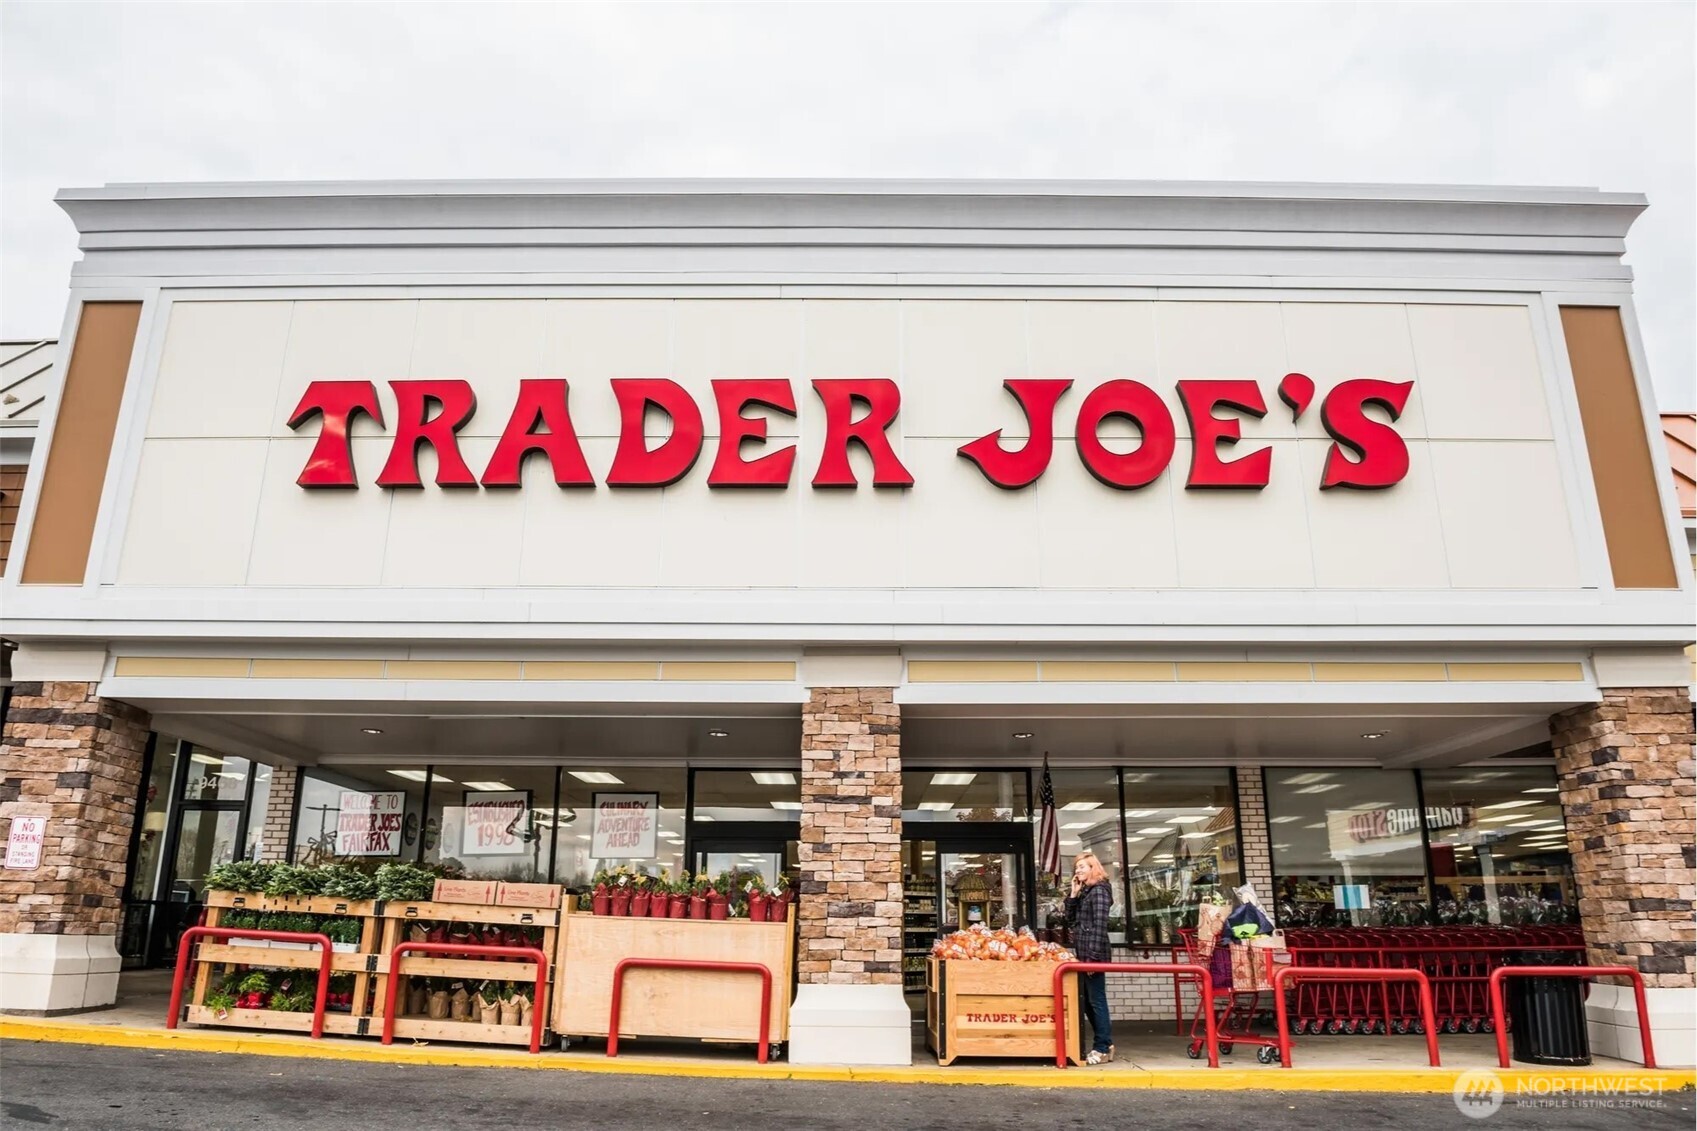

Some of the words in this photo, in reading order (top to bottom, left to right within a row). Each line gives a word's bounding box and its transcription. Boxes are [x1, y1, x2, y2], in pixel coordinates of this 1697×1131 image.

[286, 377, 915, 491] TRADER
[956, 372, 1415, 491] JOE'S
[344, 794, 382, 810] WELCOME
[386, 794, 399, 810] TO
[600, 800, 648, 817] CULINARY
[21, 822, 35, 833] NO
[339, 813, 377, 831] TRADER
[377, 813, 402, 831] JOES
[597, 816, 650, 834] ADVENTURE
[12, 833, 41, 844] PARKING
[342, 831, 391, 851] FAIRFAX
[606, 832, 640, 848] AHEAD
[966, 1013, 1017, 1023] TRADER
